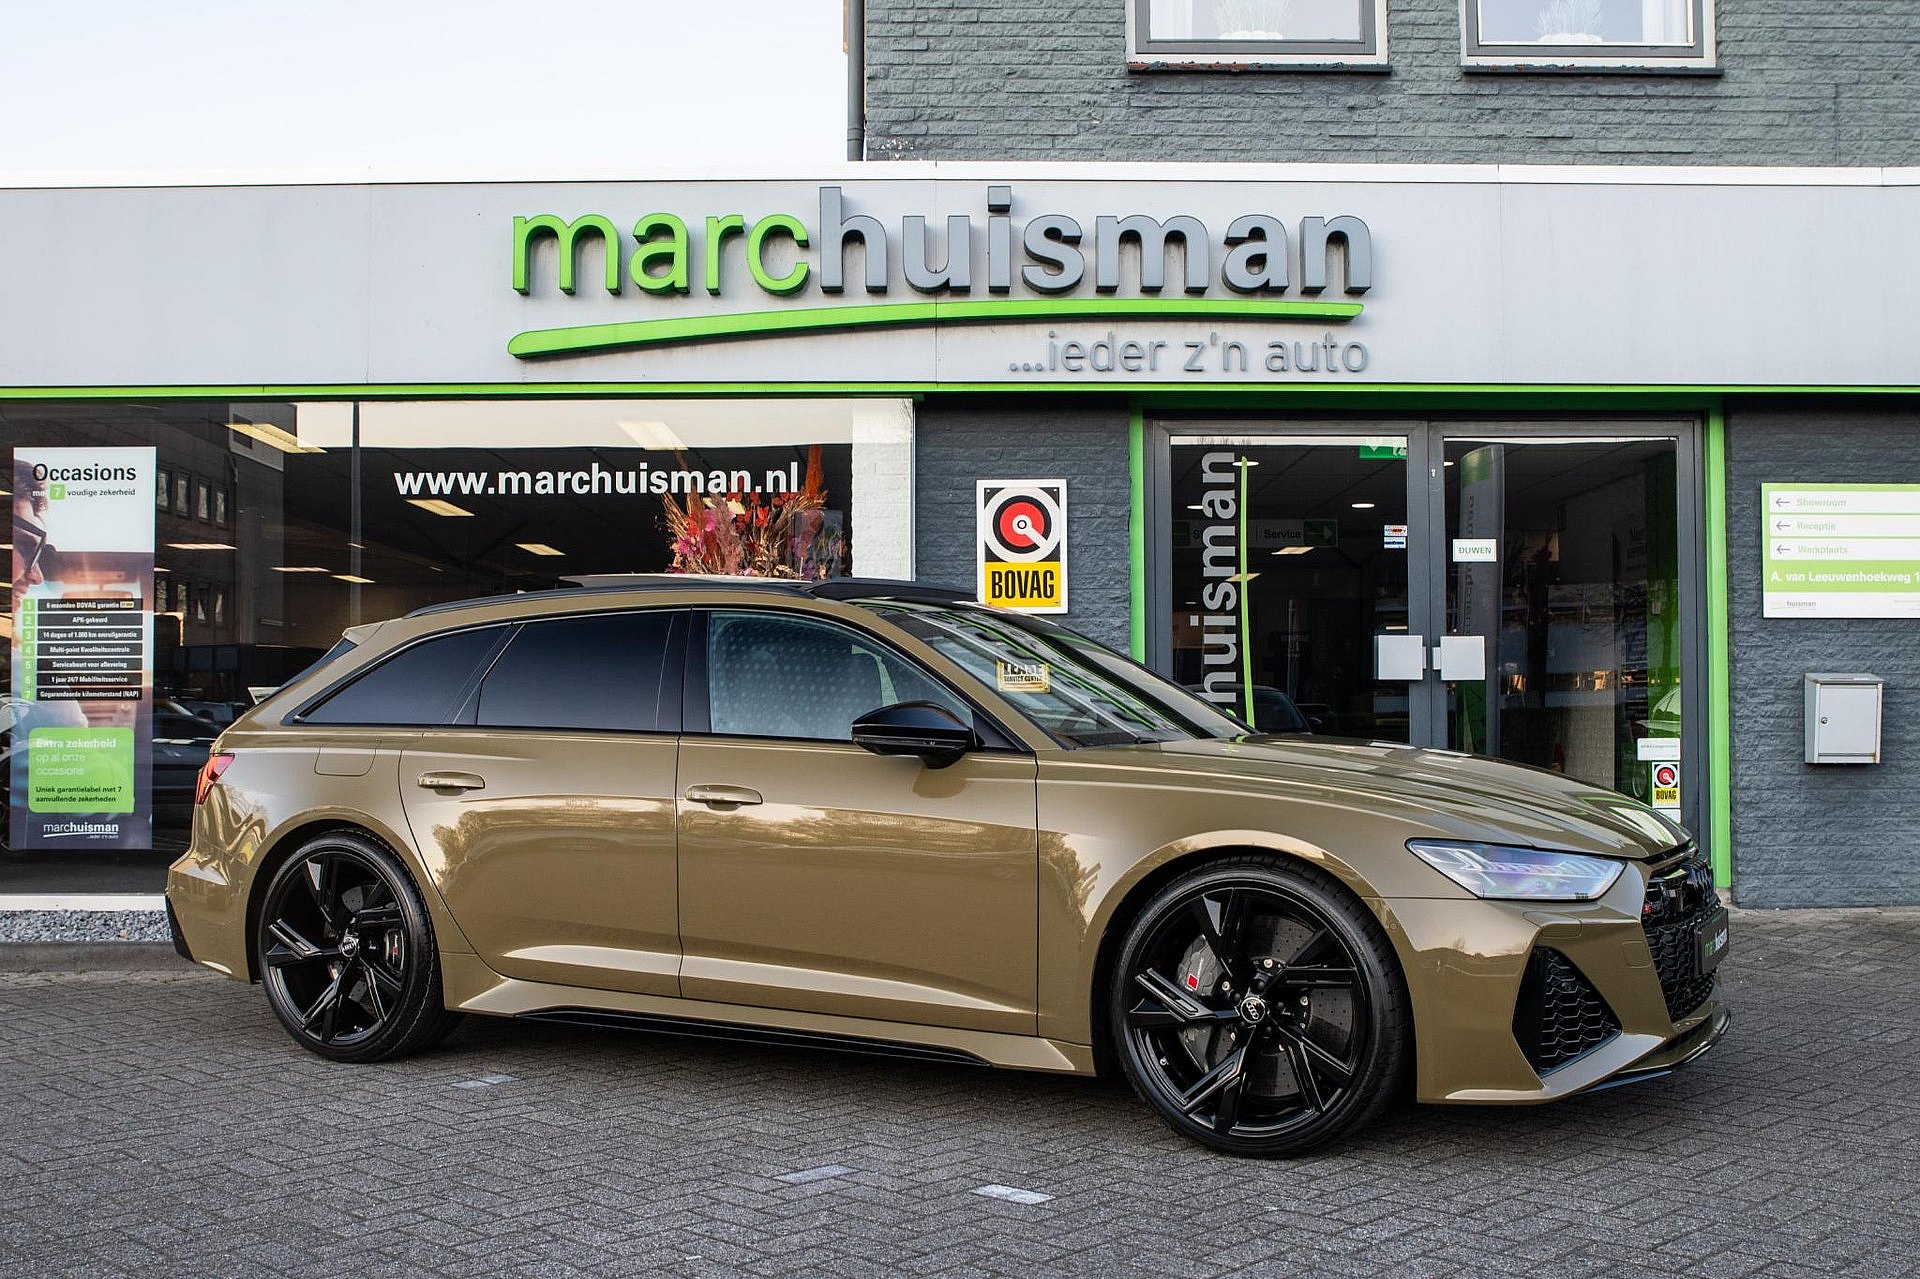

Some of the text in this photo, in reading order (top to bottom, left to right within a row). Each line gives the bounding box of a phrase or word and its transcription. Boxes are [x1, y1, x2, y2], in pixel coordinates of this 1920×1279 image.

[511, 186, 1372, 297] marchuisman
[1183, 331, 1248, 373] z'n
[1264, 331, 1370, 373] auto
[32, 463, 137, 482] Occasions
[394, 461, 800, 495] www.marchuisman.nl
[66, 488, 98, 498] voudige
[99, 487, 136, 496] zekerheid
[1796, 498, 1847, 507] Showroom
[1797, 545, 1848, 555] Werkplaats
[1190, 451, 1238, 716] huisman
[1785, 573, 1806, 582] van
[1808, 571, 1911, 584] Leeuwenhoekweg
[991, 570, 1055, 599] BOVAG
[66, 738, 116, 748] zekerheid
[57, 786, 101, 794] garantielabel
[1655, 790, 1677, 800] BOVAG
[43, 822, 119, 832] marchuisman
